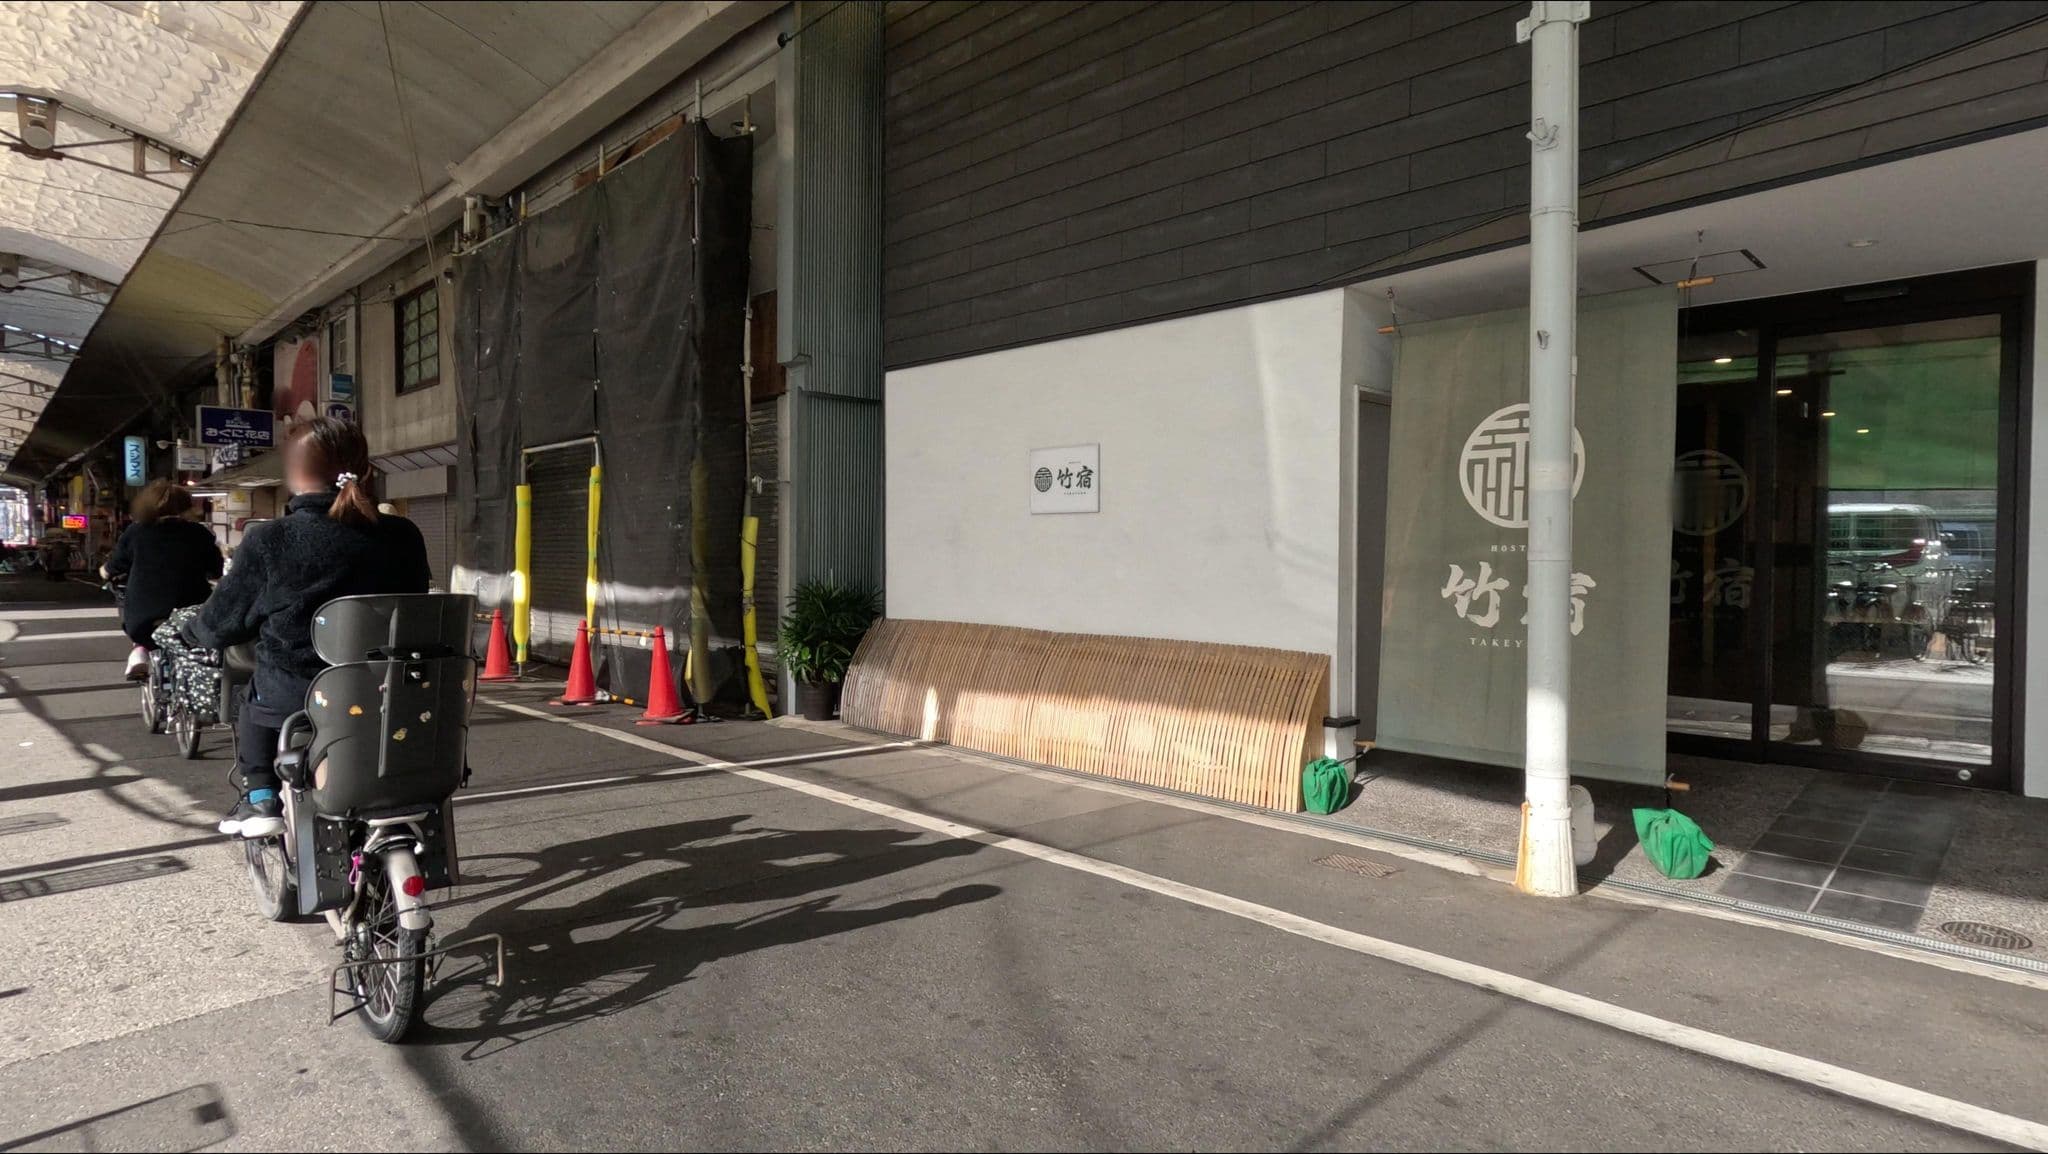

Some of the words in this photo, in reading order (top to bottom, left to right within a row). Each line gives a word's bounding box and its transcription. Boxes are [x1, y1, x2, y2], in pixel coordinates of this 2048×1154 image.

[1057, 465, 1094, 489] 竹宿
[1490, 544, 1527, 552] HOST
[1469, 637, 1527, 648] TAKEY
